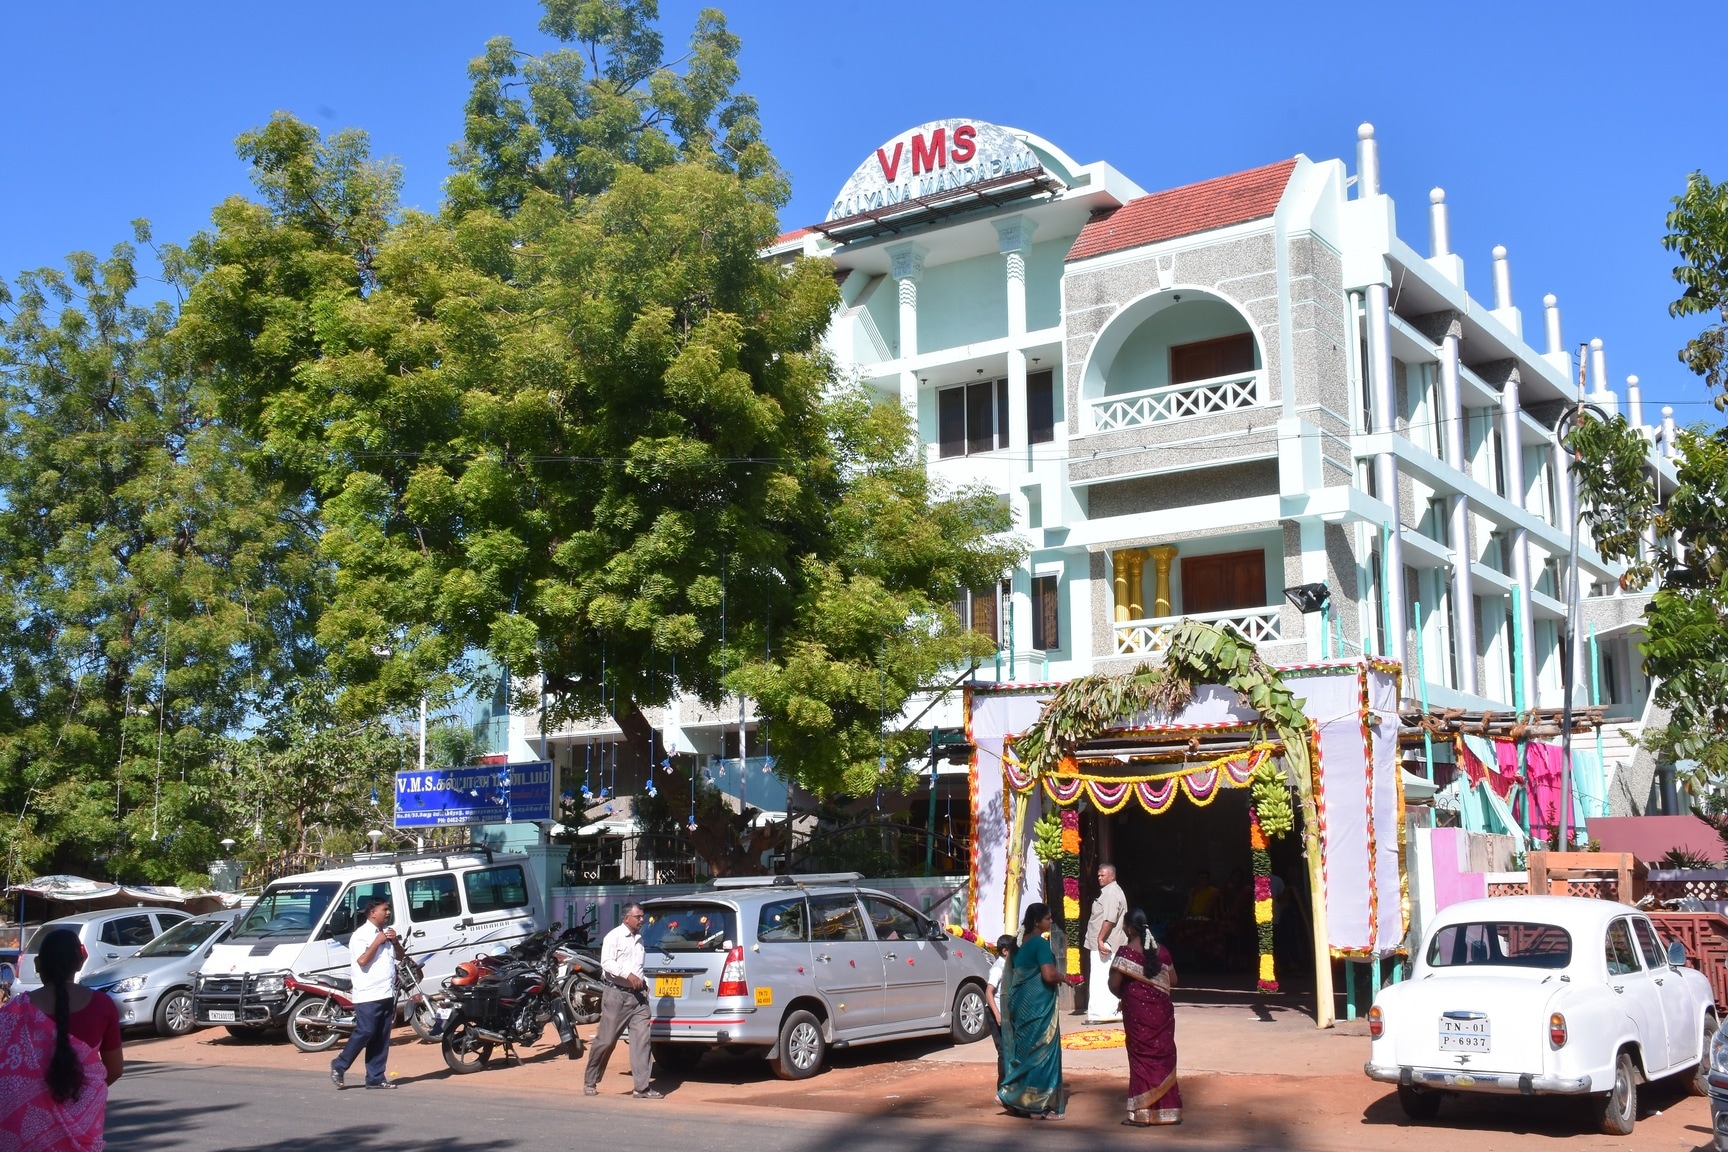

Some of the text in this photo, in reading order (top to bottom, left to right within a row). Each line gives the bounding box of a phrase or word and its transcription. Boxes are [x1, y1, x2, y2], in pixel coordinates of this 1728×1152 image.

[830, 151, 1033, 221] KALYANA MANDAPAM
[876, 125, 977, 183] VMS
